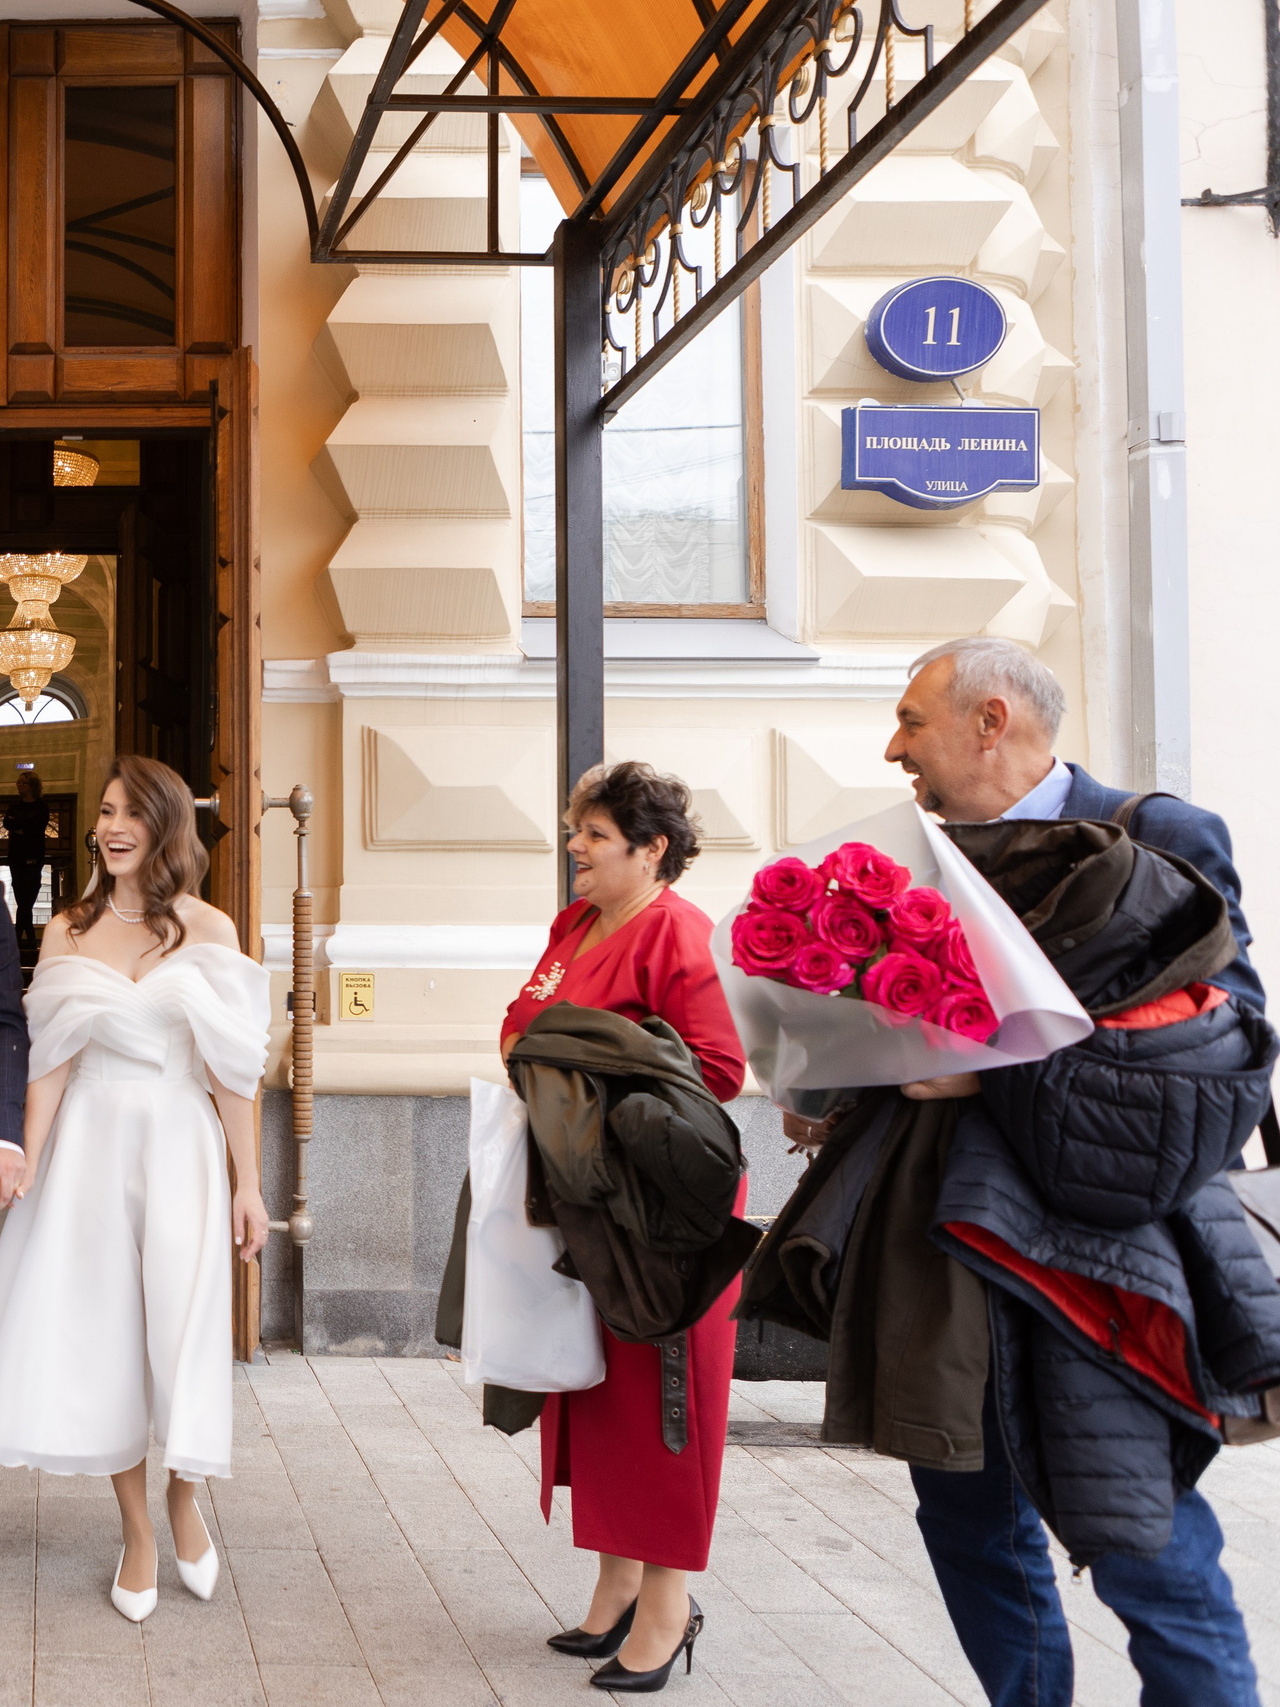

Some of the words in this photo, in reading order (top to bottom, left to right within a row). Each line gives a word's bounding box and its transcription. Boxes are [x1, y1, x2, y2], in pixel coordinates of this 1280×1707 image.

[922, 306, 962, 346] 11
[865, 436, 951, 452] ПЛОЩАДЬ
[957, 438, 1029, 452] ЛЕНИНА
[925, 480, 969, 493] УЛИЦА
